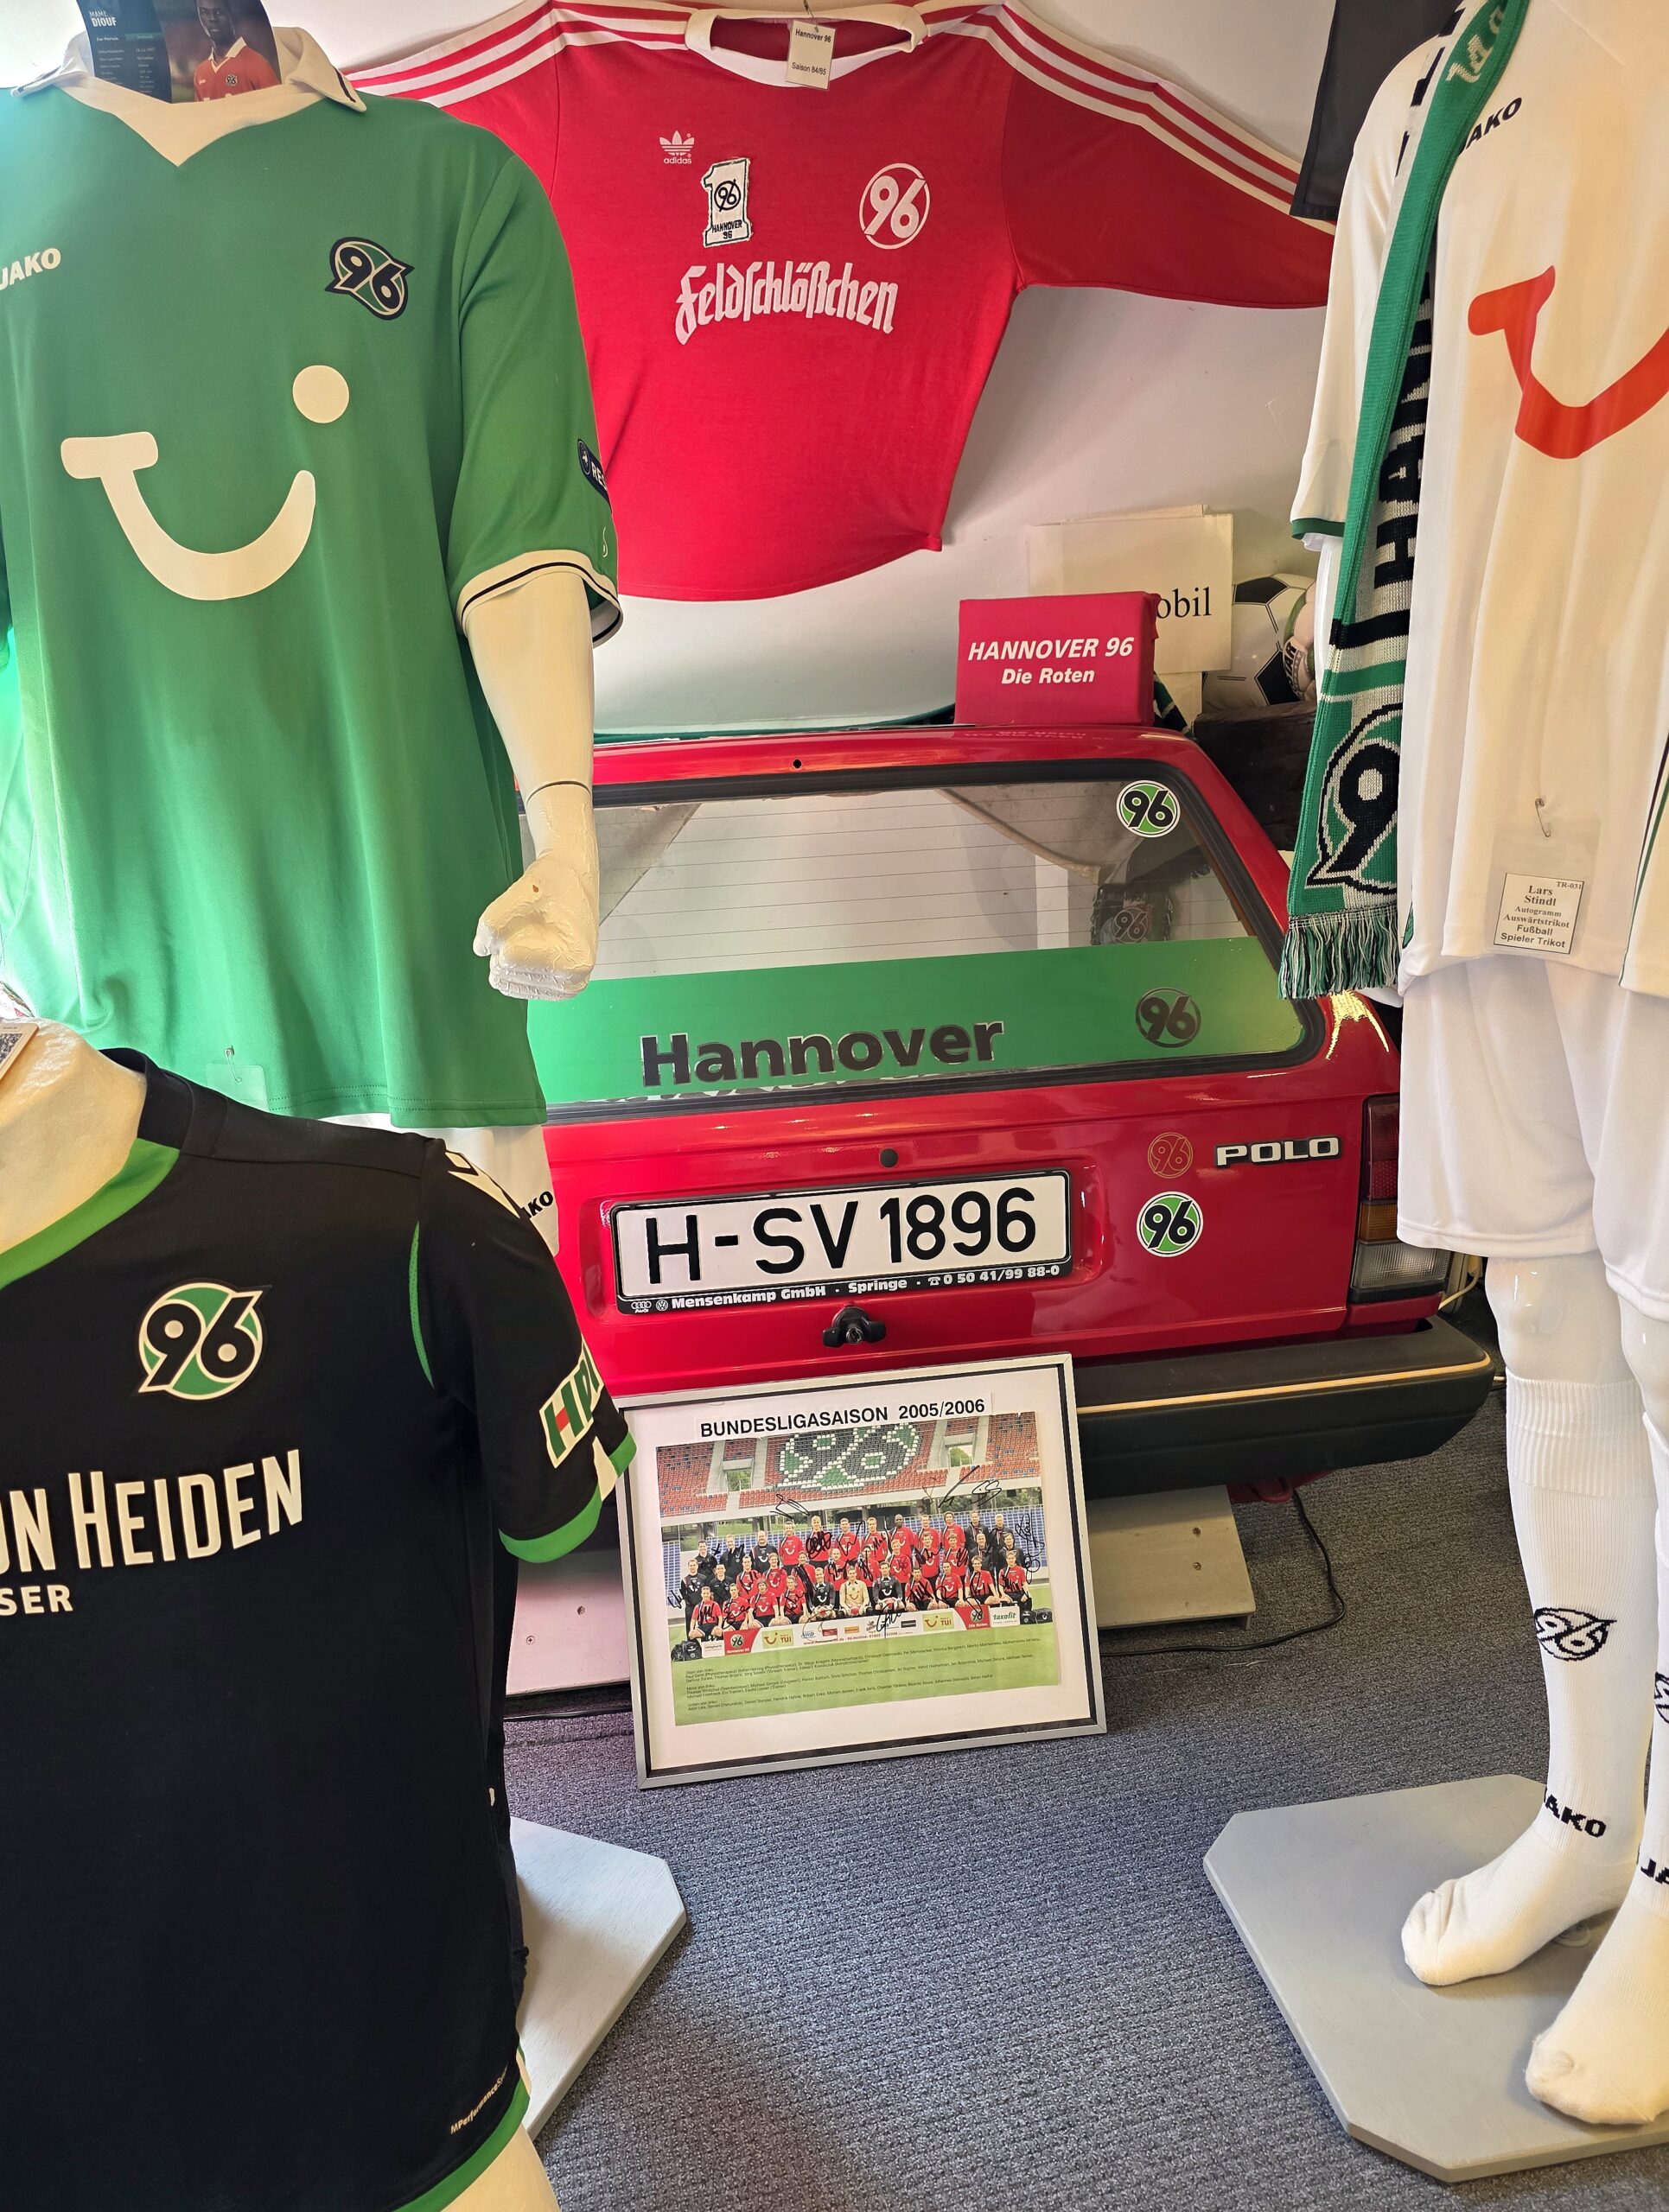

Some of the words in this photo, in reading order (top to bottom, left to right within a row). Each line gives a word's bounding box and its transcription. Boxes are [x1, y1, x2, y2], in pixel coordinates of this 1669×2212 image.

[92, 17, 117, 27] DIOUF
[795, 29, 823, 41] Hannover
[824, 35, 831, 43] 96
[792, 61, 811, 73] Saison
[811, 66, 827, 76] 84/85
[863, 175, 927, 239] 96
[711, 219, 742, 233] HANNOVER
[723, 231, 733, 239] 96
[0, 247, 61, 290] JAKO
[333, 244, 407, 312] 96
[1156, 587, 1213, 619] obil
[968, 638, 1099, 661] HANNOVER
[1105, 636, 1135, 657] 96
[1001, 668, 1032, 684] Die
[1039, 667, 1095, 683] Roten
[1123, 787, 1175, 830] 96
[1524, 895, 1557, 906] Stindl
[1528, 885, 1553, 895] Lars
[1556, 880, 1582, 890] TR-031
[1504, 914, 1570, 928] Auswärtstrikot
[1514, 906, 1562, 918] Autogramm
[1500, 932, 1534, 944] Spieler
[1538, 937, 1565, 948] Trikot
[1516, 924, 1553, 936] Fußball
[1140, 995, 1198, 1040] 96
[640, 1020, 1005, 1088] Hannover
[1151, 1136, 1191, 1175] 96
[1215, 1135, 1341, 1166] POLO
[646, 1200, 858, 1284] H-SV
[879, 1187, 1036, 1263] 1896
[1143, 1198, 1197, 1249] 96
[672, 1288, 776, 1309] Mensenkamp
[780, 1285, 826, 1300] GmbH
[848, 1279, 908, 1294] Springe
[943, 1274, 952, 1285] 0
[957, 1272, 976, 1284] 50
[979, 1268, 1022, 1282] 41/99
[1027, 1265, 1060, 1278] 88-0
[142, 1293, 260, 1390] 96
[700, 1406, 889, 1438] BUNDESLIGASAISON
[898, 1399, 985, 1420] 2005/2006
[68, 1449, 303, 1569] HEIDEN
[1544, 1789, 1607, 1839] AKO
